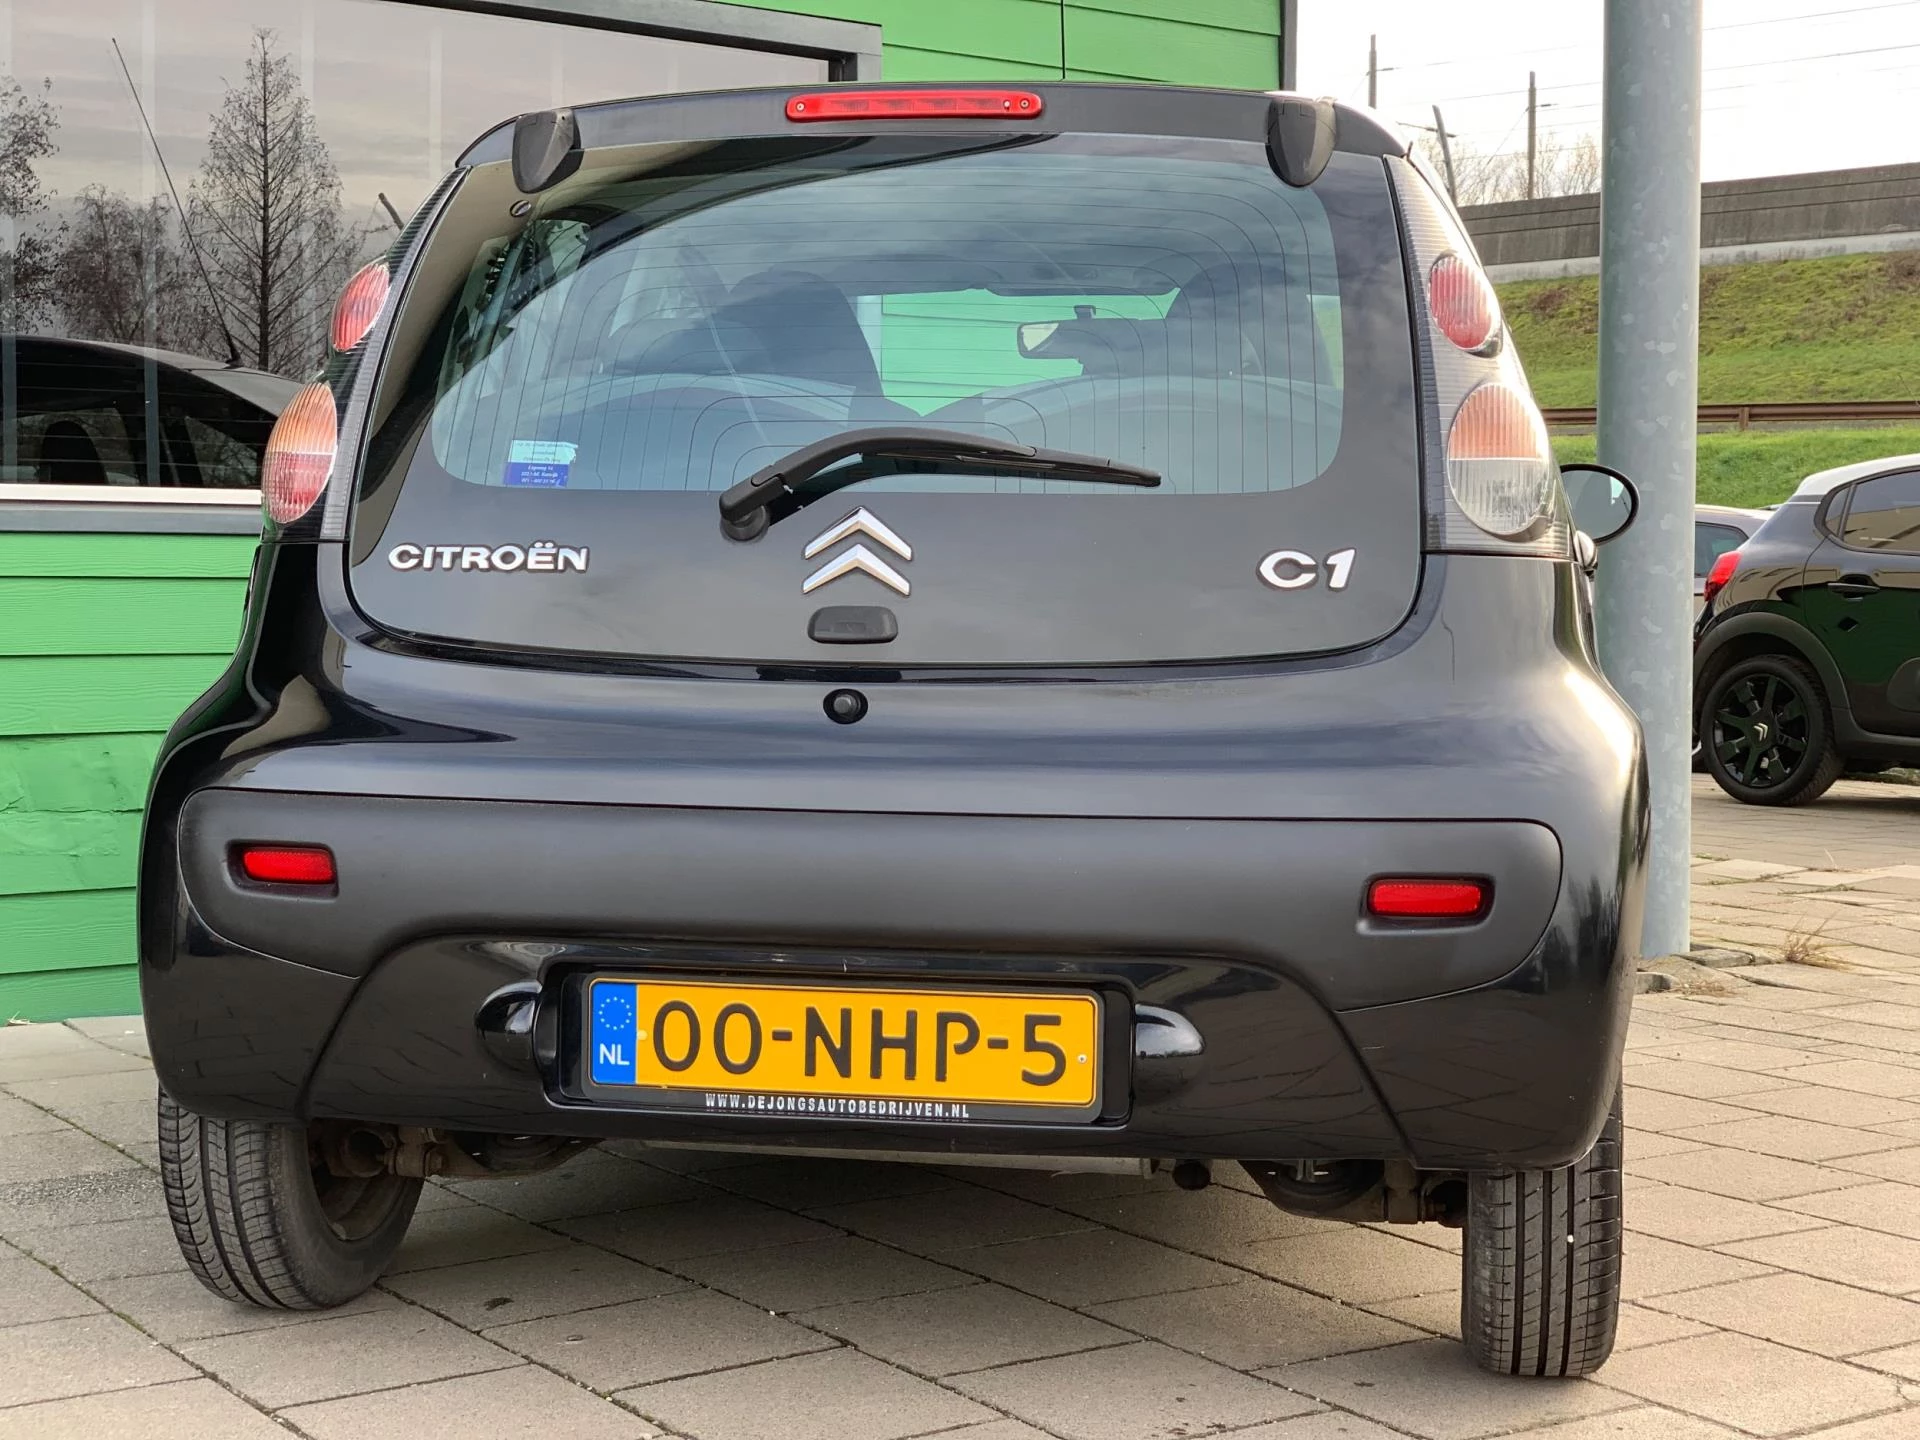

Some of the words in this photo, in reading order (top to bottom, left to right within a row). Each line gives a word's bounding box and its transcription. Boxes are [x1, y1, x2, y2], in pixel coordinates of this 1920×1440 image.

[387, 541, 589, 571] CITROËN
[1258, 548, 1356, 589] C1
[599, 1043, 630, 1066] NL
[652, 999, 1067, 1087] 00-NHP-5
[705, 1092, 969, 1118] WWW.DEJONGSAUTOBEDRIJVEN.NL
